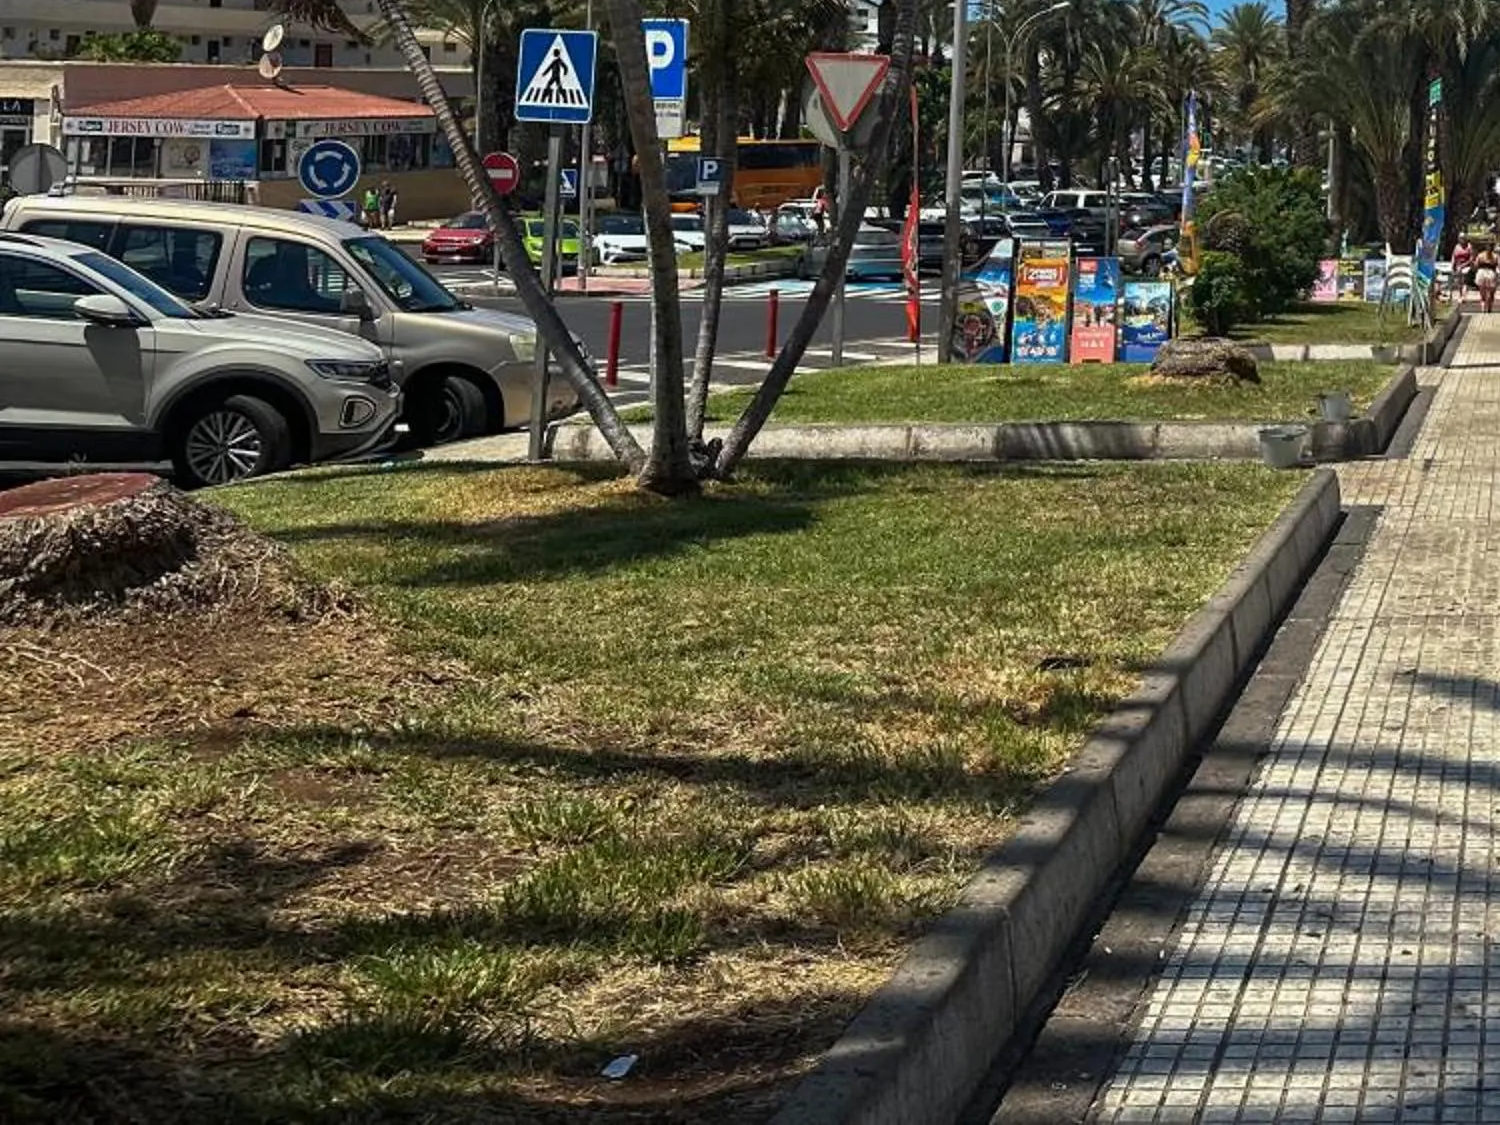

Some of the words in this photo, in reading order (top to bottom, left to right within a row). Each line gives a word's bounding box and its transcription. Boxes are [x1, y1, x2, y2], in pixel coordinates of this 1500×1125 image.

[107, 120, 151, 134] JERSEY
[155, 121, 184, 134] COW
[702, 160, 718, 180] P
